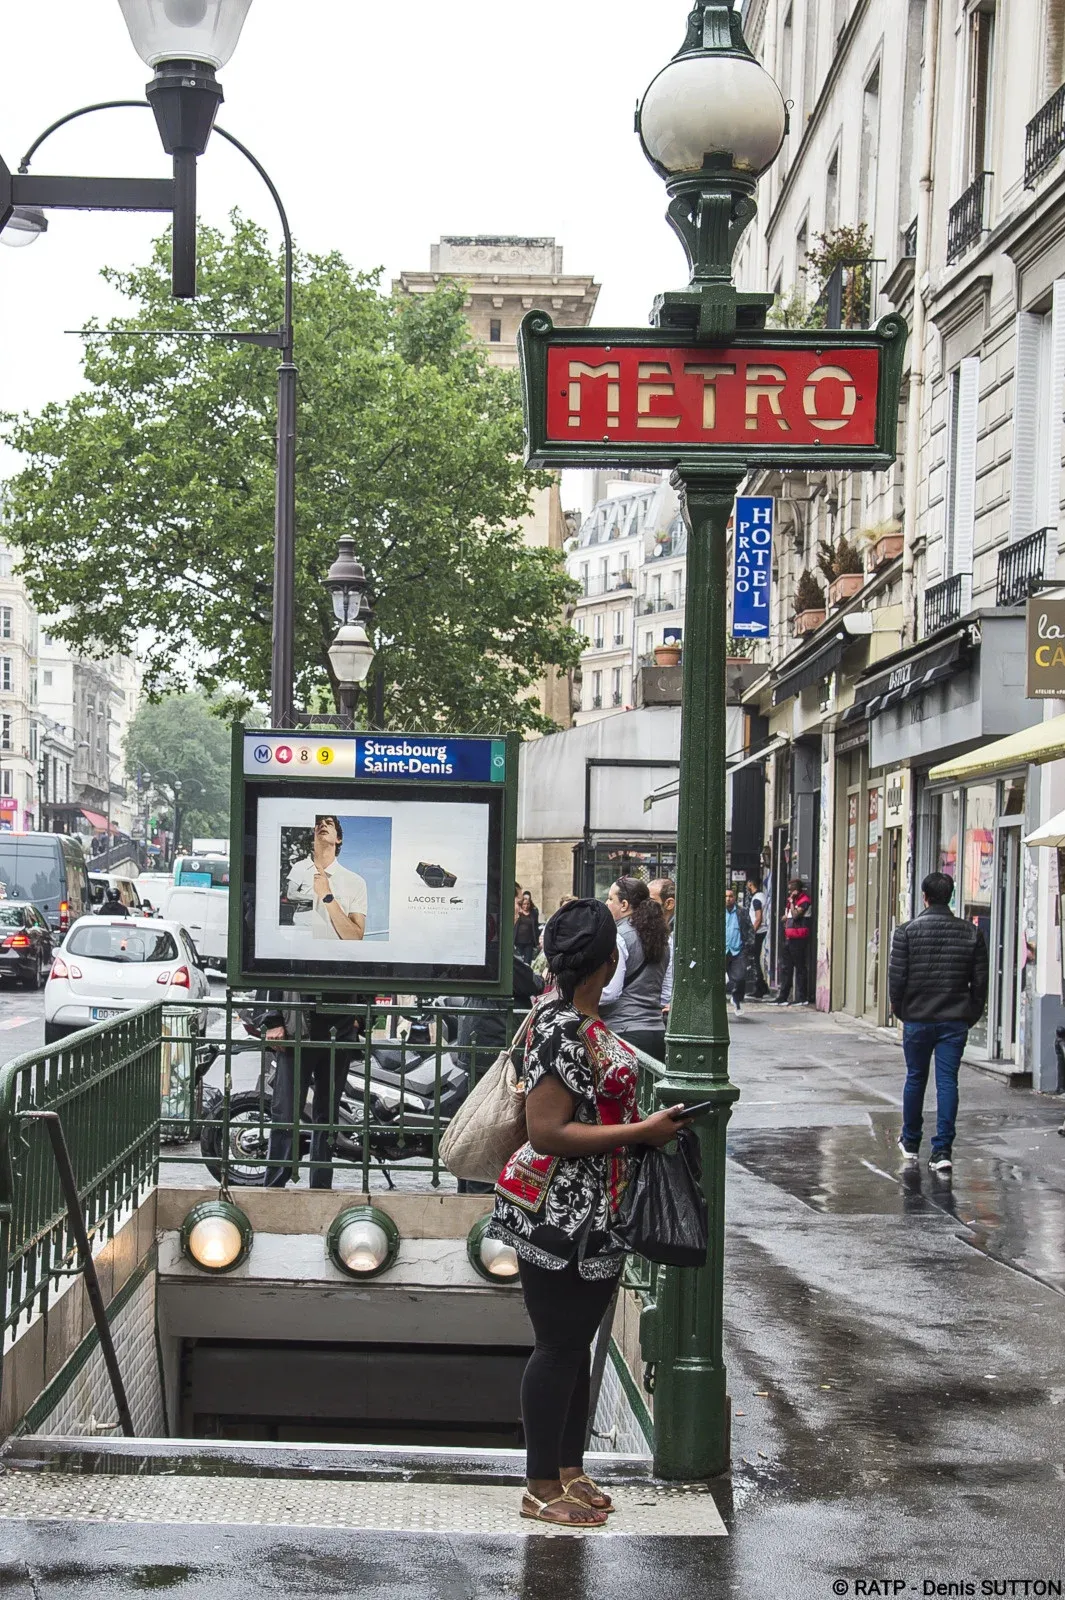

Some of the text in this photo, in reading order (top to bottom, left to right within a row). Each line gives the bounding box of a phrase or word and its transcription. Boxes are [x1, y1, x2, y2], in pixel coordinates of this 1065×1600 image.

[567, 361, 857, 431] METRO
[736, 521, 750, 593] PRADO
[751, 507, 771, 608] HOTEL
[1037, 613, 1065, 639] la
[300, 749, 308, 761] 8
[321, 750, 329, 762] 9
[364, 740, 448, 760] Strasbourg
[364, 757, 453, 775] Saint-Denis
[407, 896, 446, 904] LACOSTE
